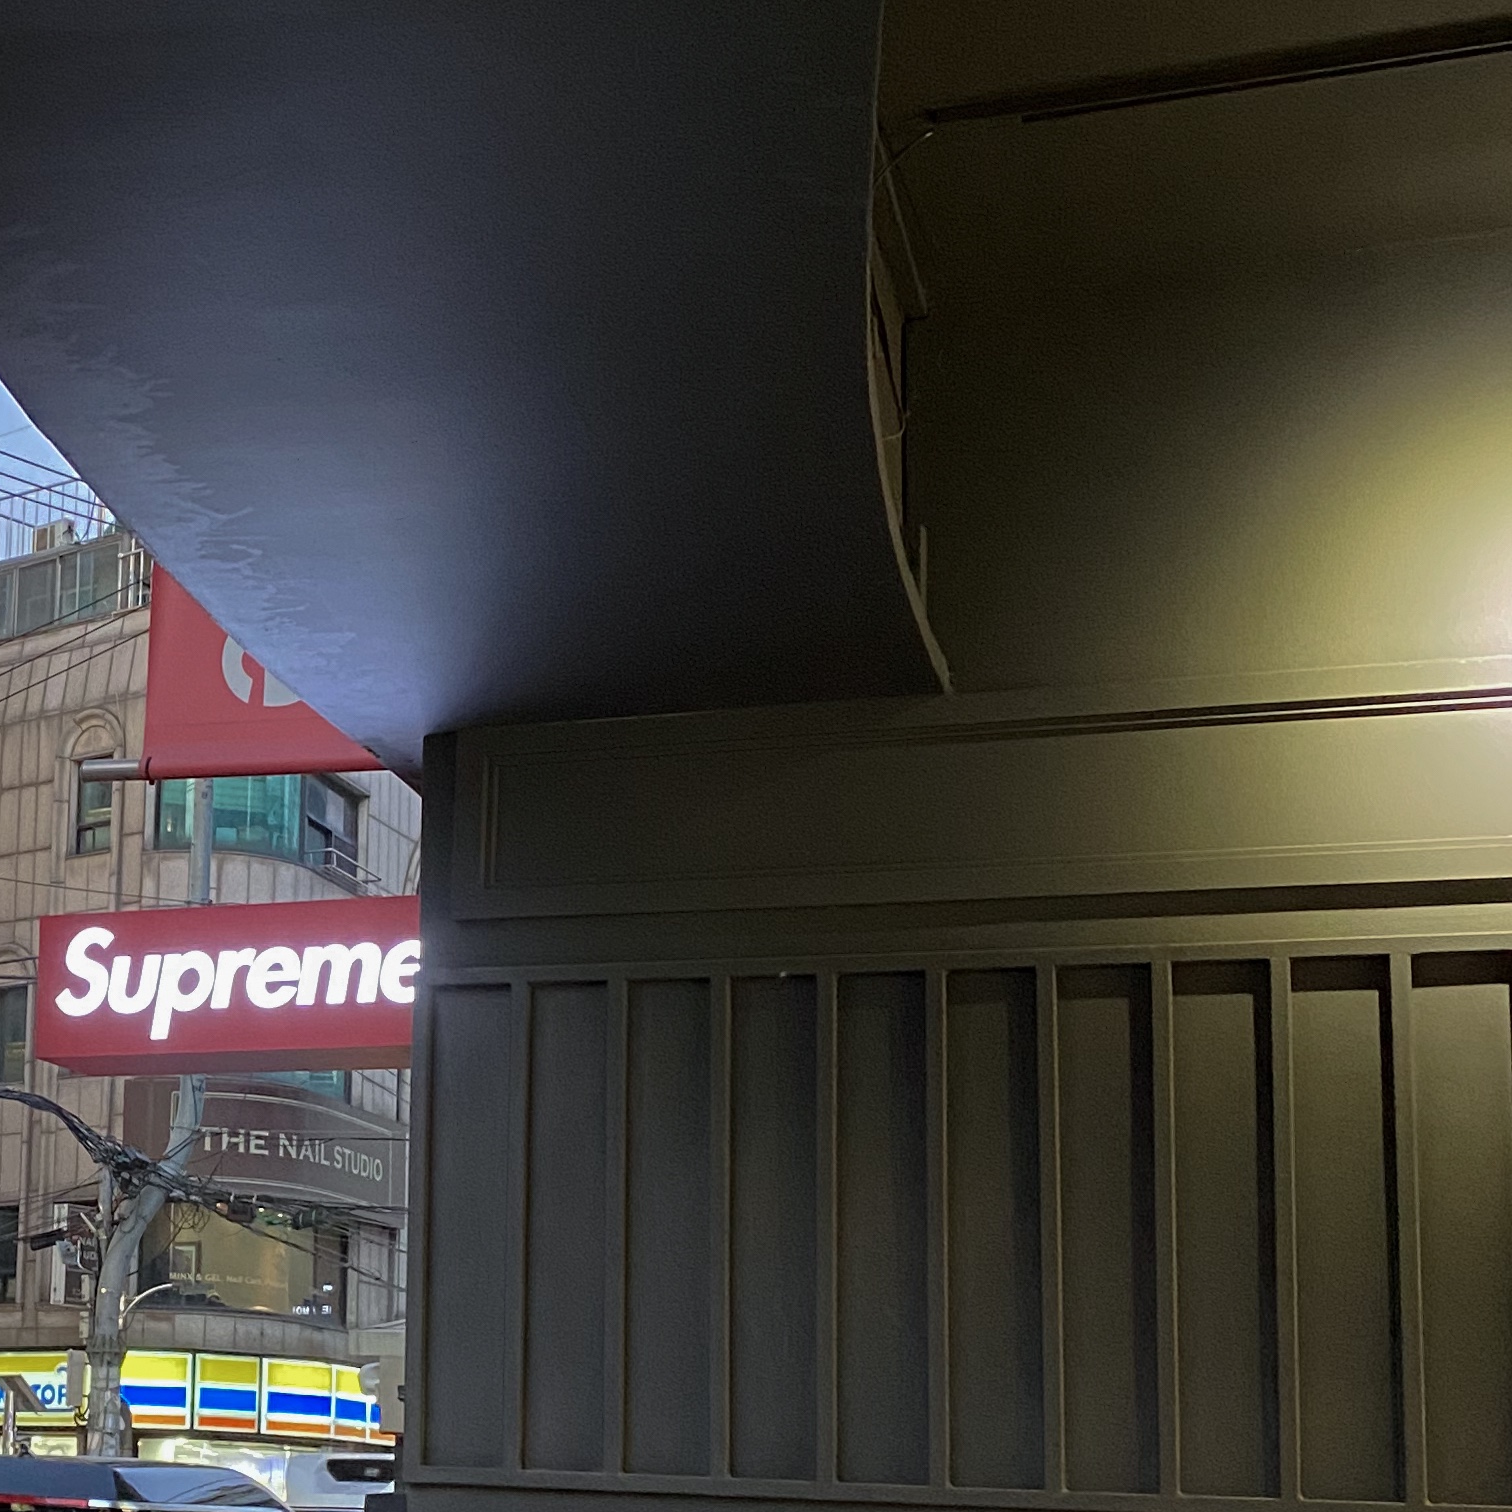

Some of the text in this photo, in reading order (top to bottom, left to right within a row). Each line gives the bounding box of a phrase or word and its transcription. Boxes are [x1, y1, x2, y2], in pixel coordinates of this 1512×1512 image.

[54, 927, 421, 1040] Supreme
[200, 1126, 383, 1181] THE NAIL STUDIO
